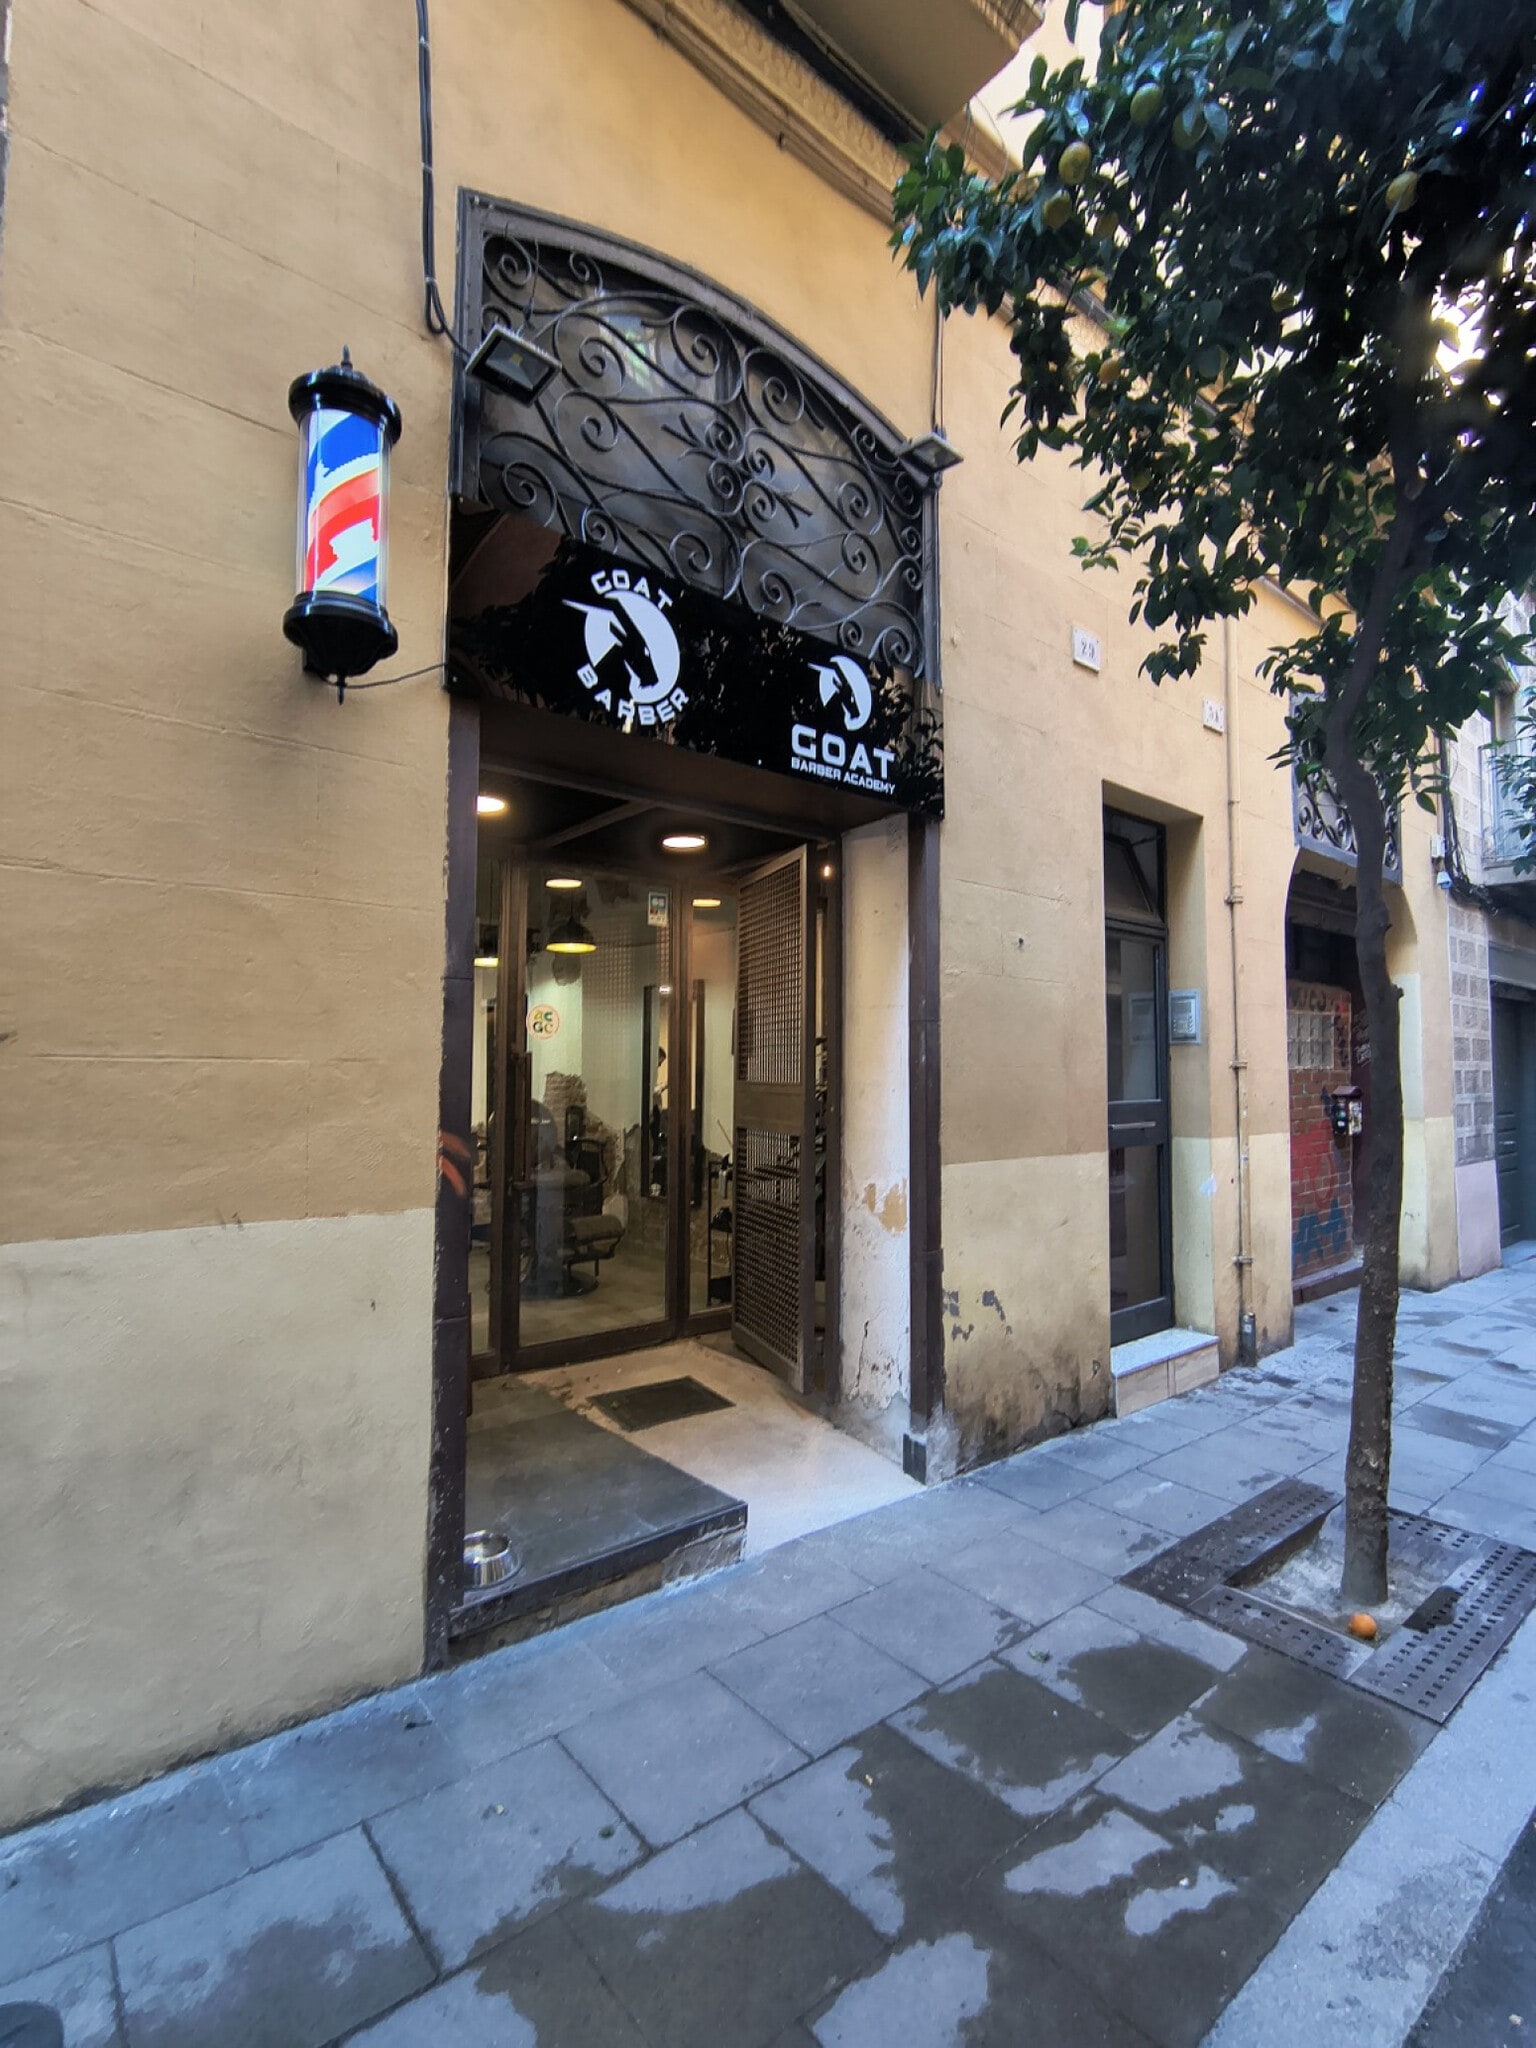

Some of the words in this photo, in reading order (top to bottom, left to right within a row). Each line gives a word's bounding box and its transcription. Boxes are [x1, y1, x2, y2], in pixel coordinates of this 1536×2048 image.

[591, 569, 673, 610] GOAT
[576, 663, 689, 726] BARBER
[791, 723, 895, 780] GOAT
[791, 756, 841, 781] BARBER
[843, 771, 896, 795] ACADEMY
